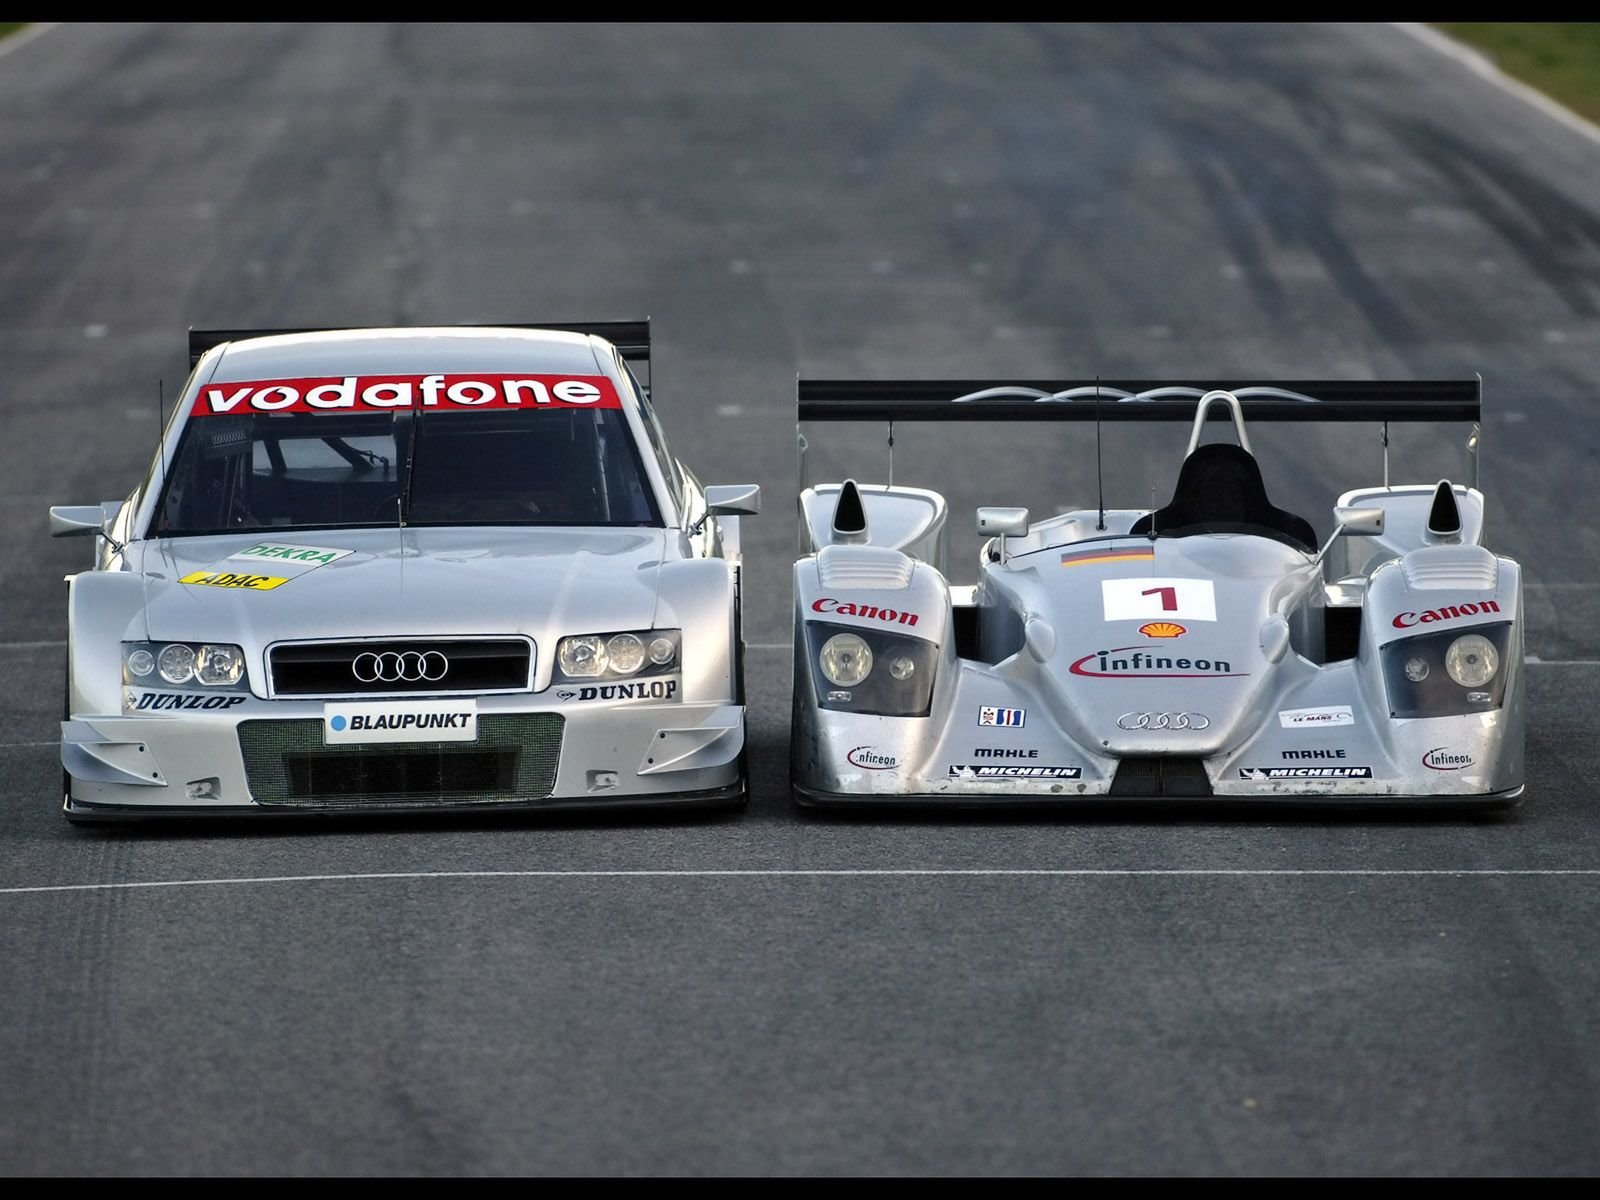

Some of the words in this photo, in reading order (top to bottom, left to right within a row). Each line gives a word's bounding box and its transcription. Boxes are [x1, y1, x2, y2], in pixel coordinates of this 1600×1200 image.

[207, 375, 601, 413] vodafone
[241, 545, 337, 564] DEKRA
[195, 573, 269, 588] ADAC
[1141, 587, 1178, 611] 1
[811, 598, 919, 627] Canon
[1392, 600, 1500, 629] Canon
[1097, 650, 1231, 673] infineon
[577, 680, 676, 701] DUNLOP
[136, 692, 247, 710] DUNLOP
[350, 713, 471, 730] BLAUPUNKT
[974, 748, 1039, 758] MAHLE
[1281, 749, 1346, 759] MAHLE
[978, 767, 1078, 776] MICHELIN
[1269, 768, 1367, 777] MICHELIN
